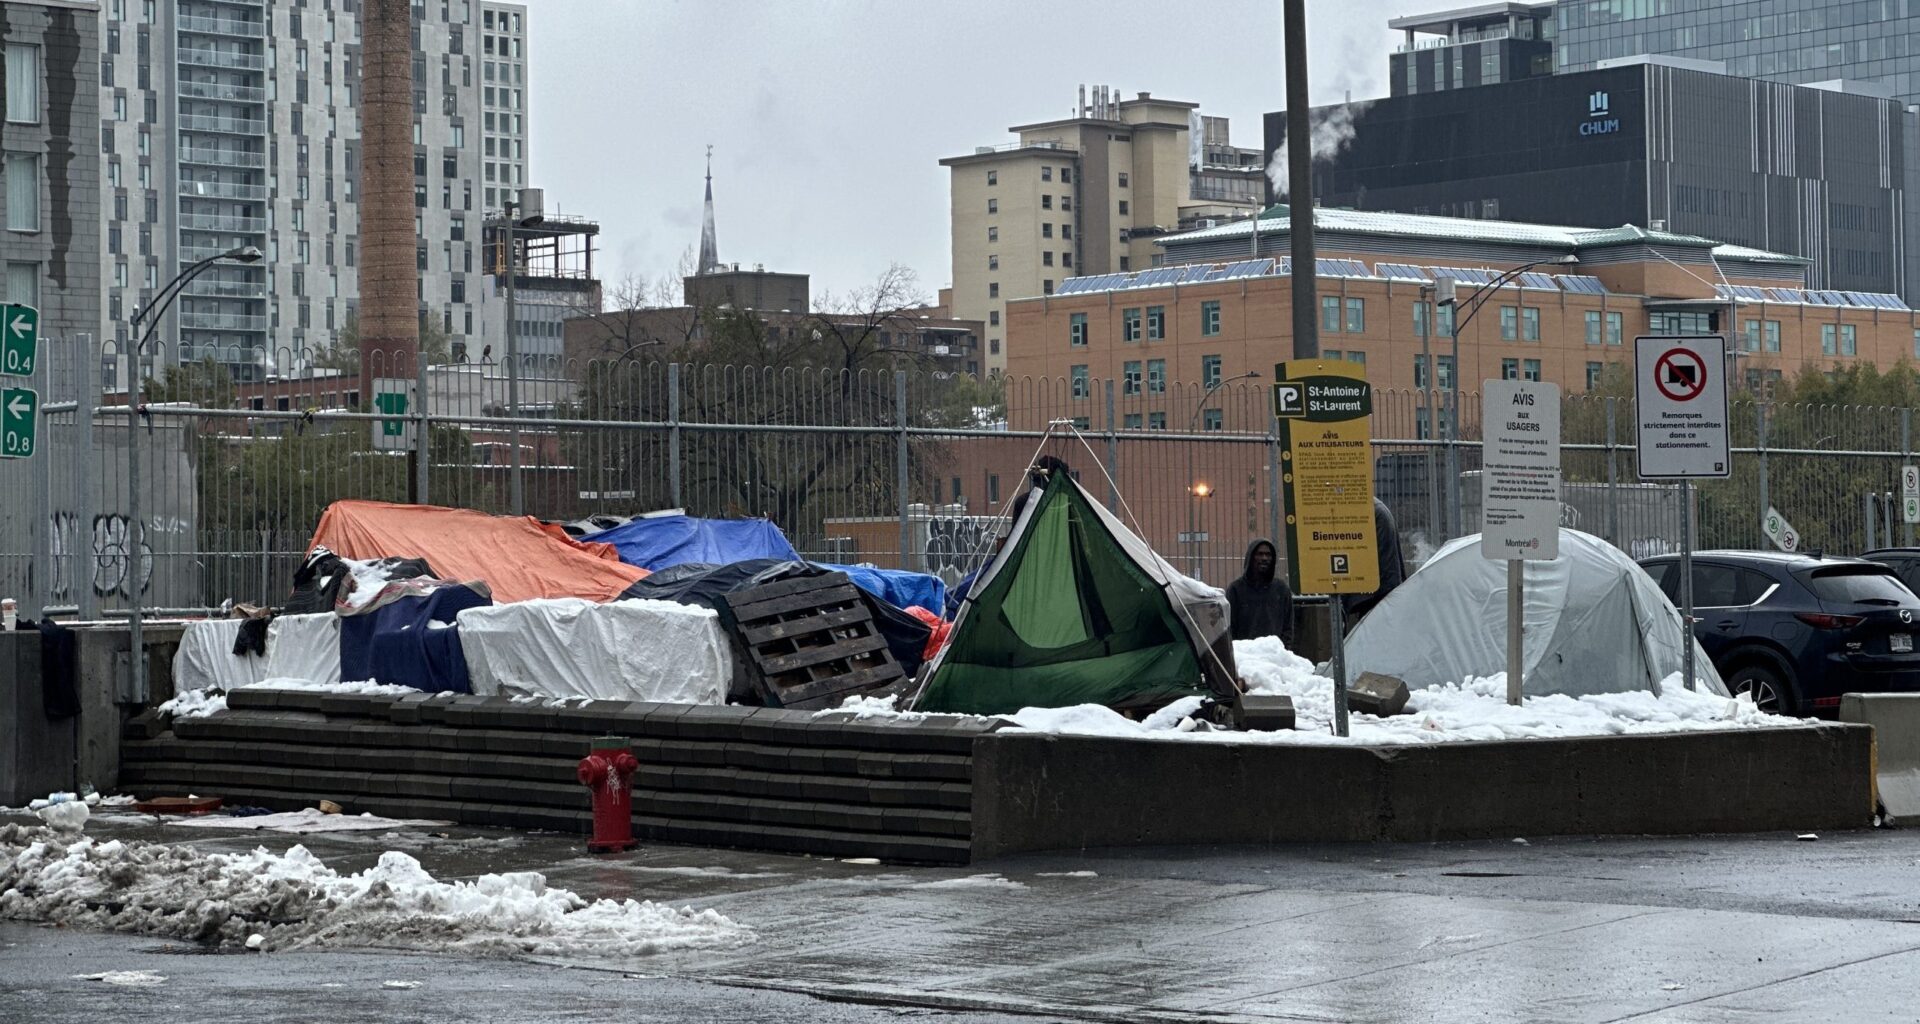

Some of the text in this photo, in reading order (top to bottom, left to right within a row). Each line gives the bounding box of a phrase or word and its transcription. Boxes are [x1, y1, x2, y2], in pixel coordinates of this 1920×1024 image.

[1579, 119, 1619, 136] CHUM
[1308, 385, 1360, 397] St-Antoine
[1512, 393, 1534, 406] AVIS
[1309, 400, 1361, 411] St-Laurent
[1517, 411, 1530, 419] aux
[1662, 411, 1702, 420] Remorques
[1506, 421, 1540, 432] USAGERS
[1643, 421, 1722, 429] strictement interdites
[1655, 441, 1711, 449] stationnement.
[1312, 530, 1363, 541] Bienvenue
[1505, 537, 1531, 548] Montréal
